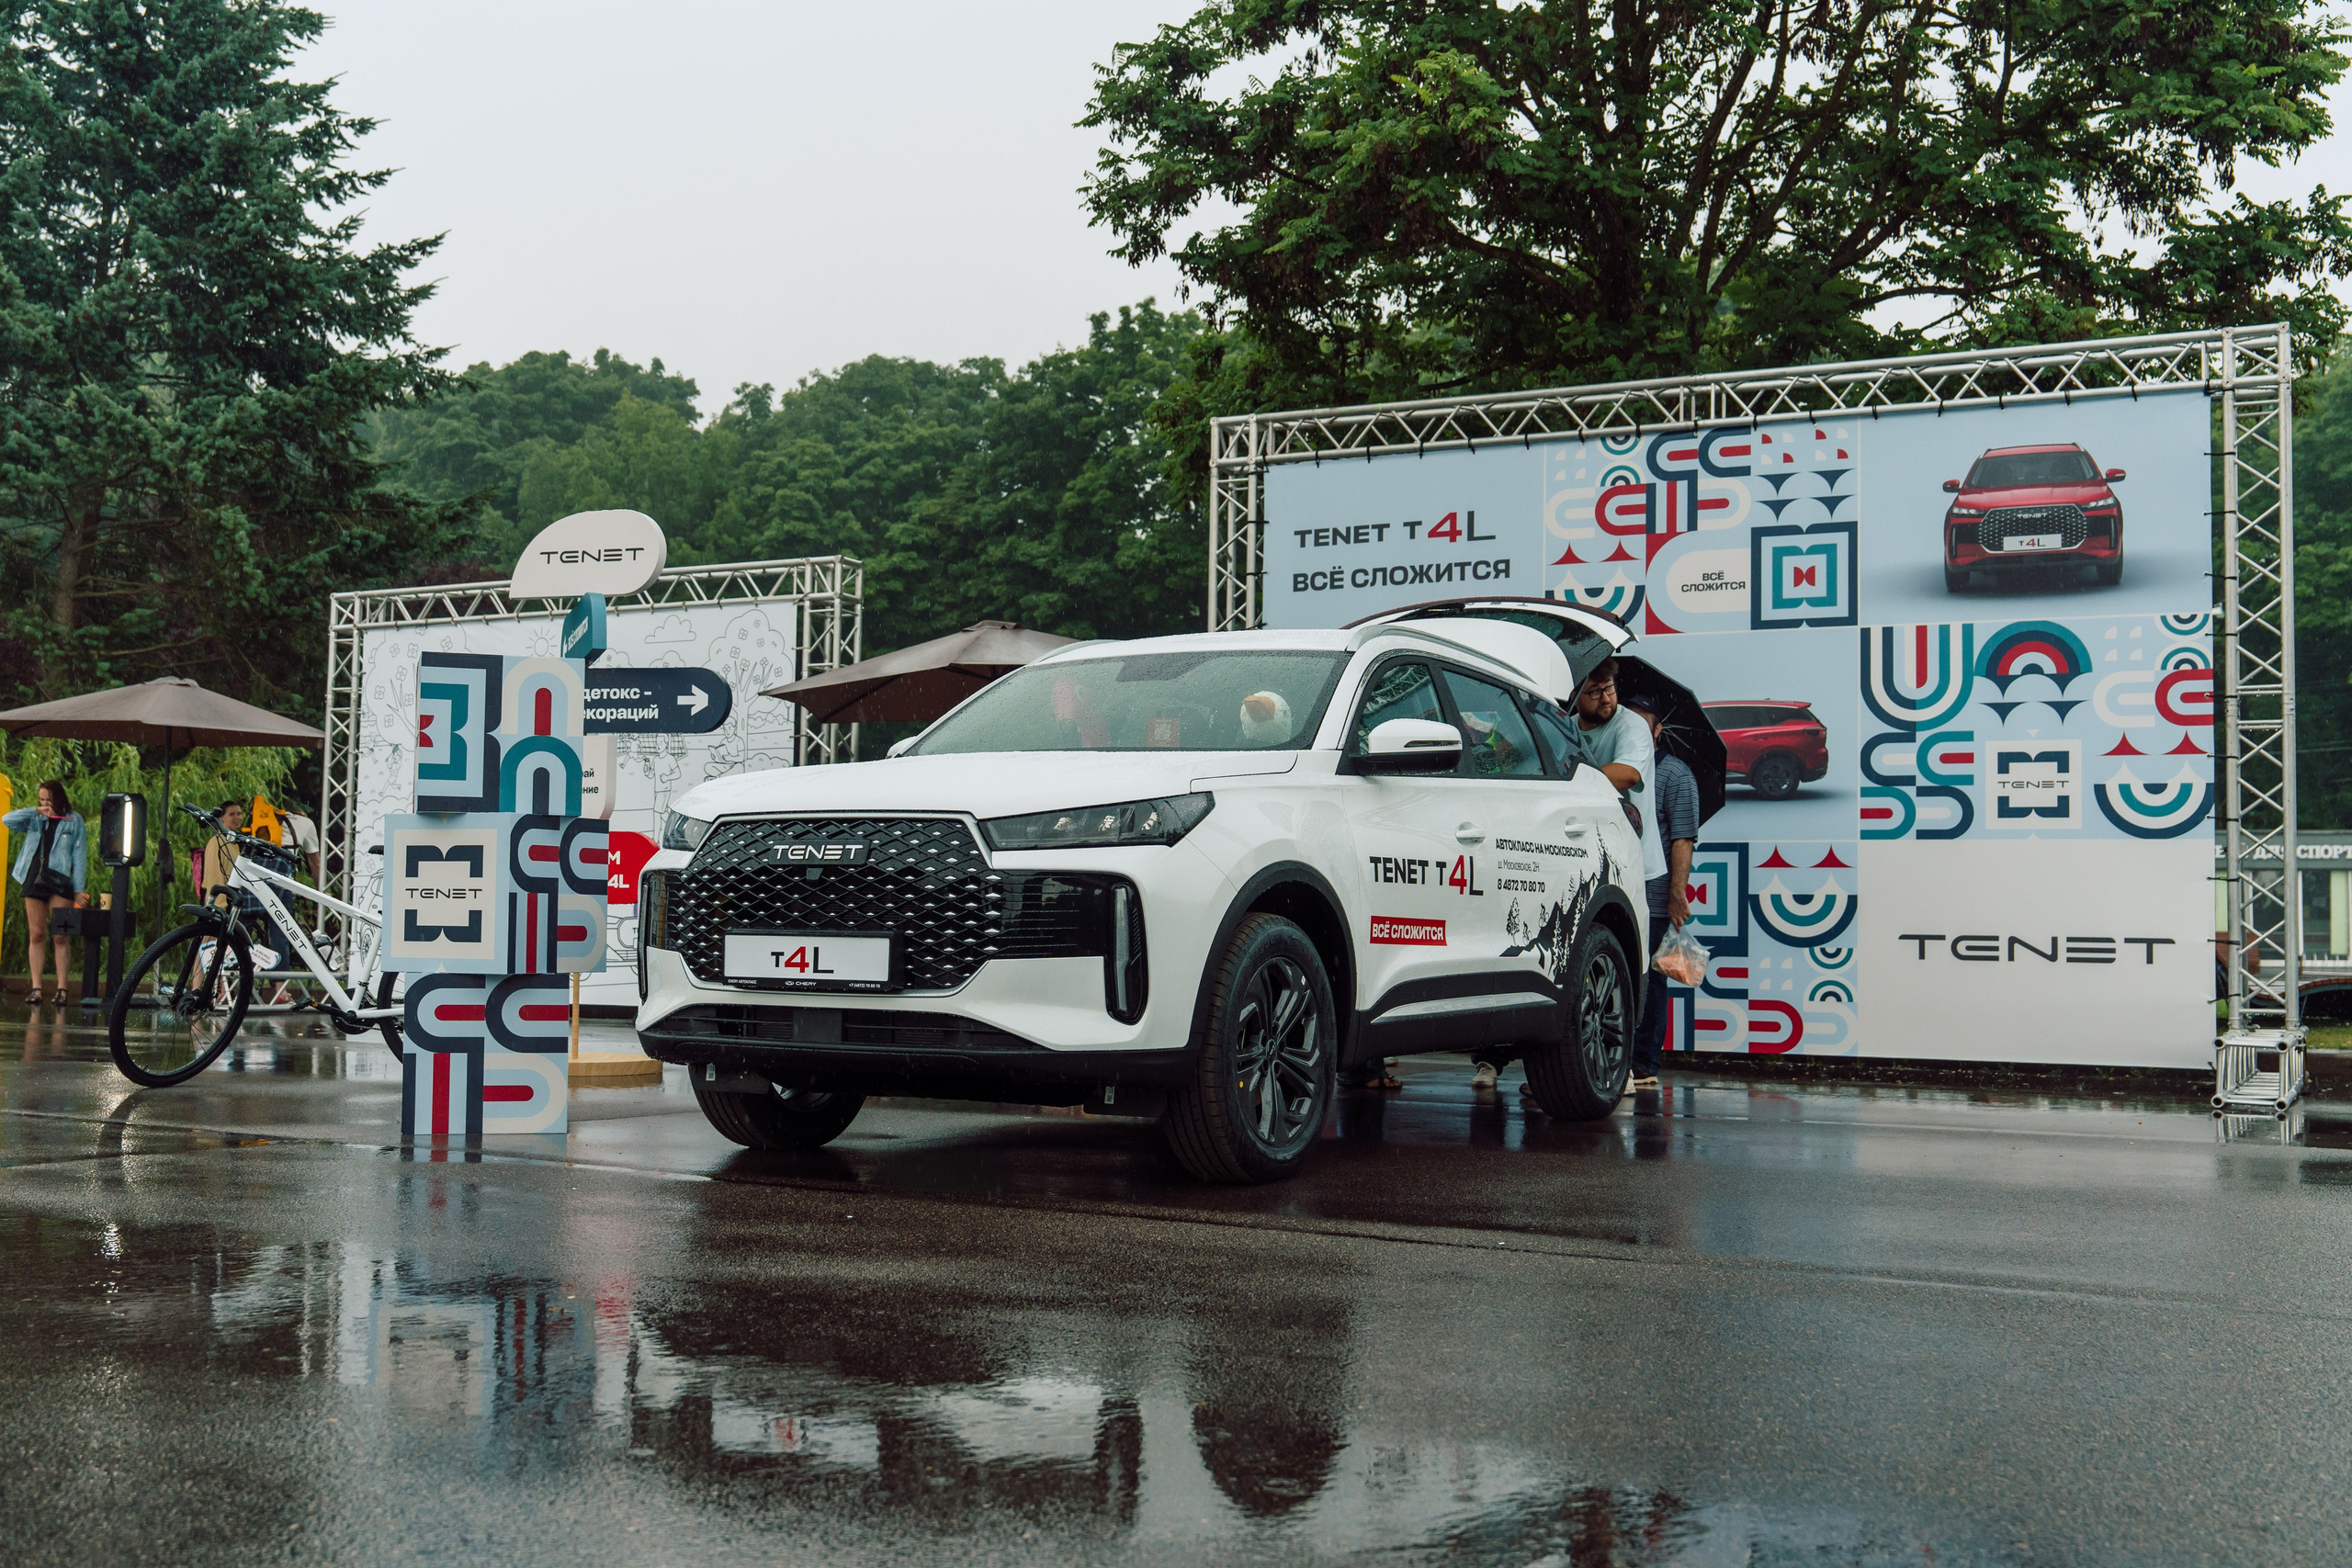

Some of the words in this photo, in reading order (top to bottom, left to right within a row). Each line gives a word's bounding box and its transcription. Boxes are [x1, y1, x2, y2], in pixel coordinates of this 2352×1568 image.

[1294, 523, 1391, 548] TENET
[1403, 511, 1496, 543] T4L
[2018, 538, 2046, 547] T4L
[539, 547, 645, 564] TENET
[1293, 566, 1344, 592] ВСЁ
[1351, 558, 1510, 588] СЛОЖИТСЯ
[1702, 570, 1724, 581] ВСЁ
[1680, 581, 1746, 592] СЛОЖИТСЯ
[583, 704, 659, 723] кораций
[773, 845, 864, 860] TENET
[1496, 839, 1534, 852] АВТОКЛАСС
[1535, 843, 1544, 854] НА
[1544, 844, 1589, 858] МОСКОВСКОМ
[1369, 856, 1429, 885] TENET
[1436, 855, 1484, 896] T4L
[405, 888, 483, 898] TENET
[1498, 878, 1502, 890] 8
[1503, 879, 1519, 891] 4872
[1521, 880, 1527, 892] 70
[1529, 881, 1536, 893] 80
[1538, 881, 1545, 893] 70
[269, 899, 307, 950] TENET
[1372, 921, 1390, 938] ВСЁ
[1391, 924, 1444, 941] СЛОЖИТСЯ
[1898, 934, 2176, 964] TENET
[771, 946, 834, 974] T4L
